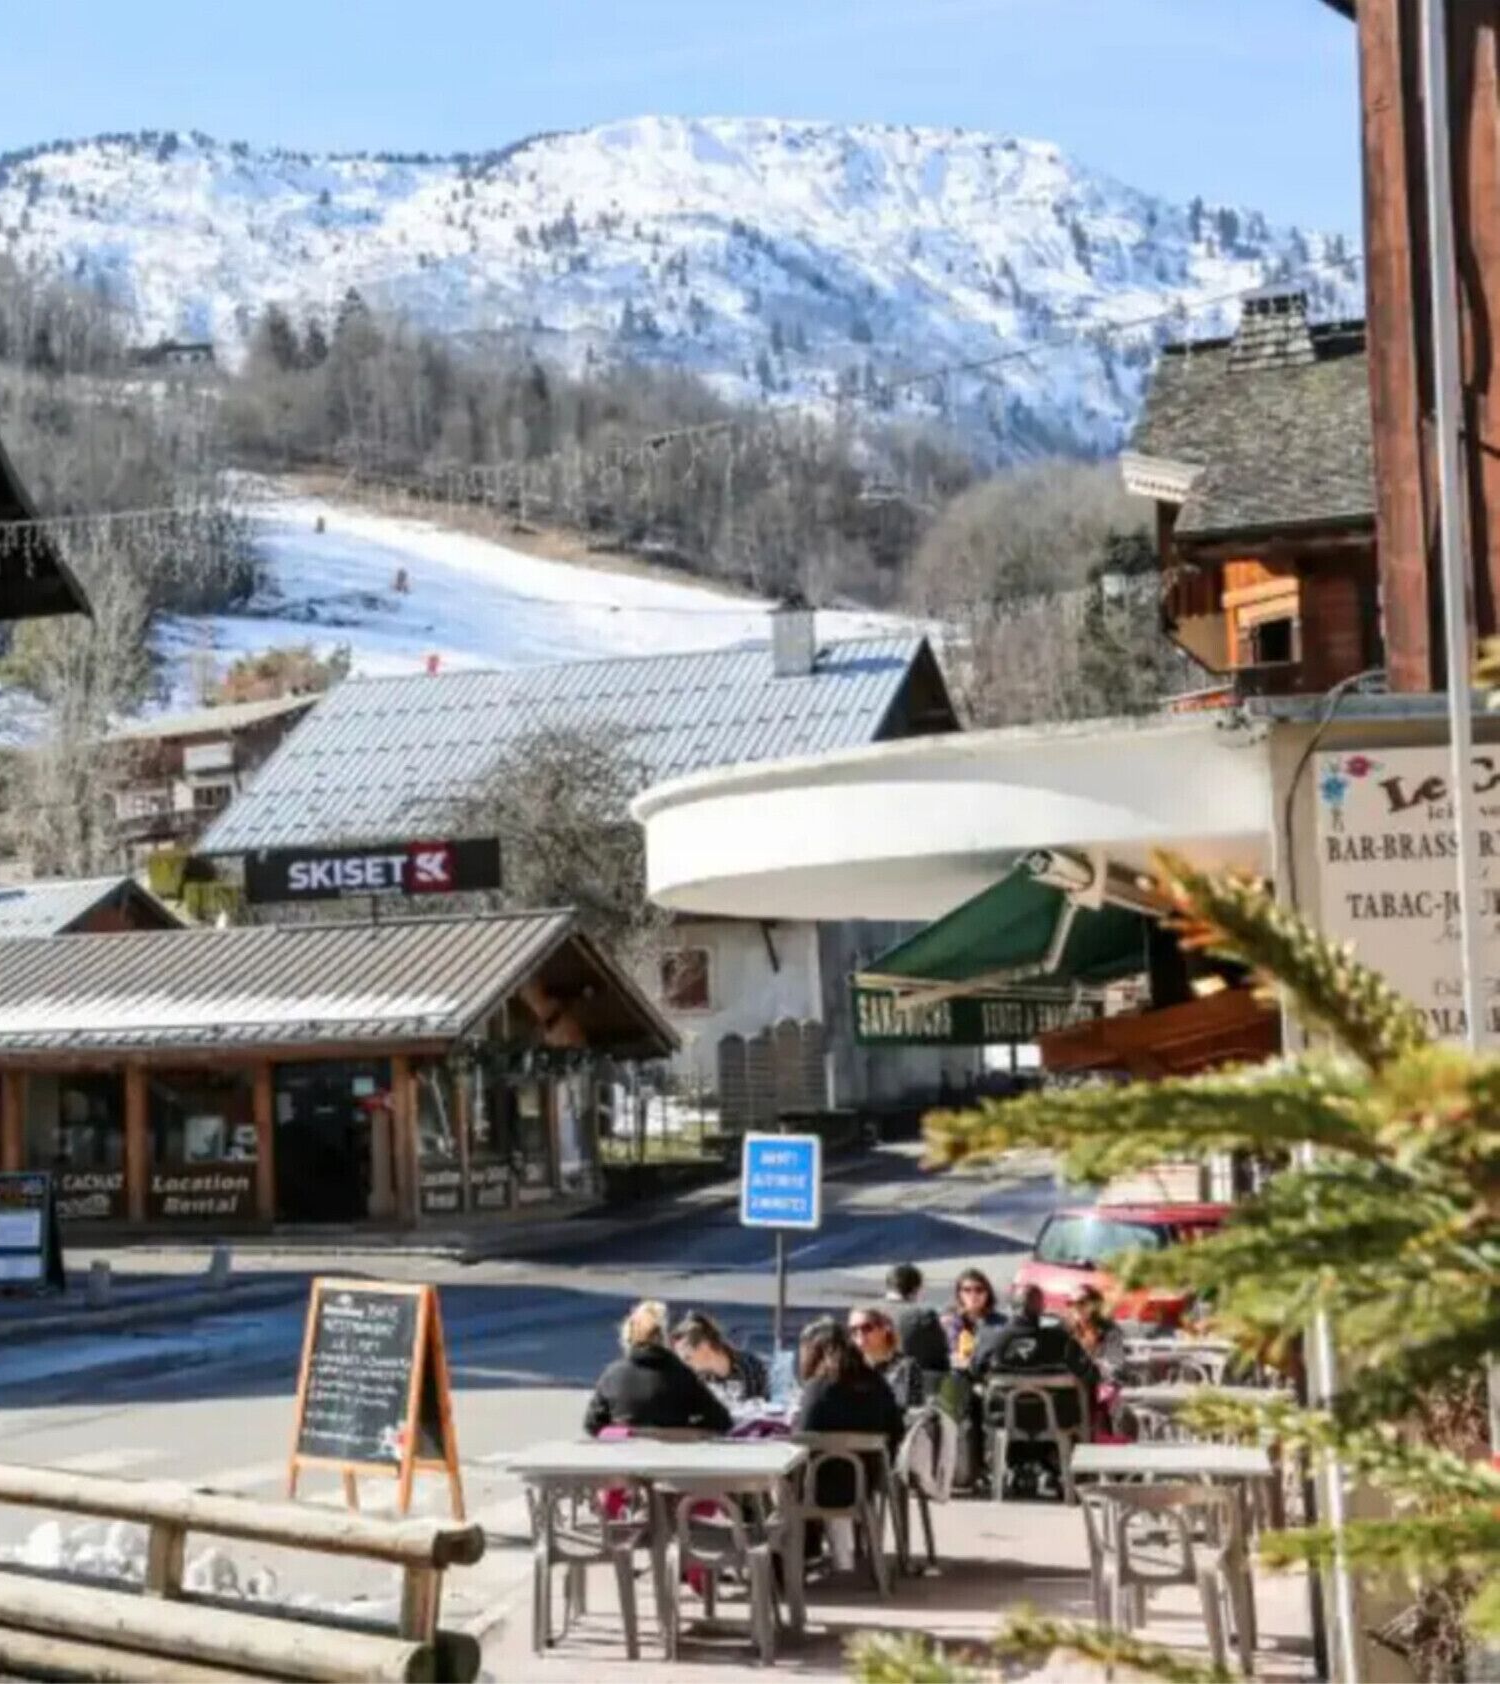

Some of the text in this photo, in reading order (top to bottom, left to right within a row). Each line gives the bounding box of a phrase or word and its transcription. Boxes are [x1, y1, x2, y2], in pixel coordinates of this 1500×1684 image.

[287, 854, 408, 891] SKISET
[152, 1174, 250, 1193] Location
[163, 1195, 239, 1215] Rental
